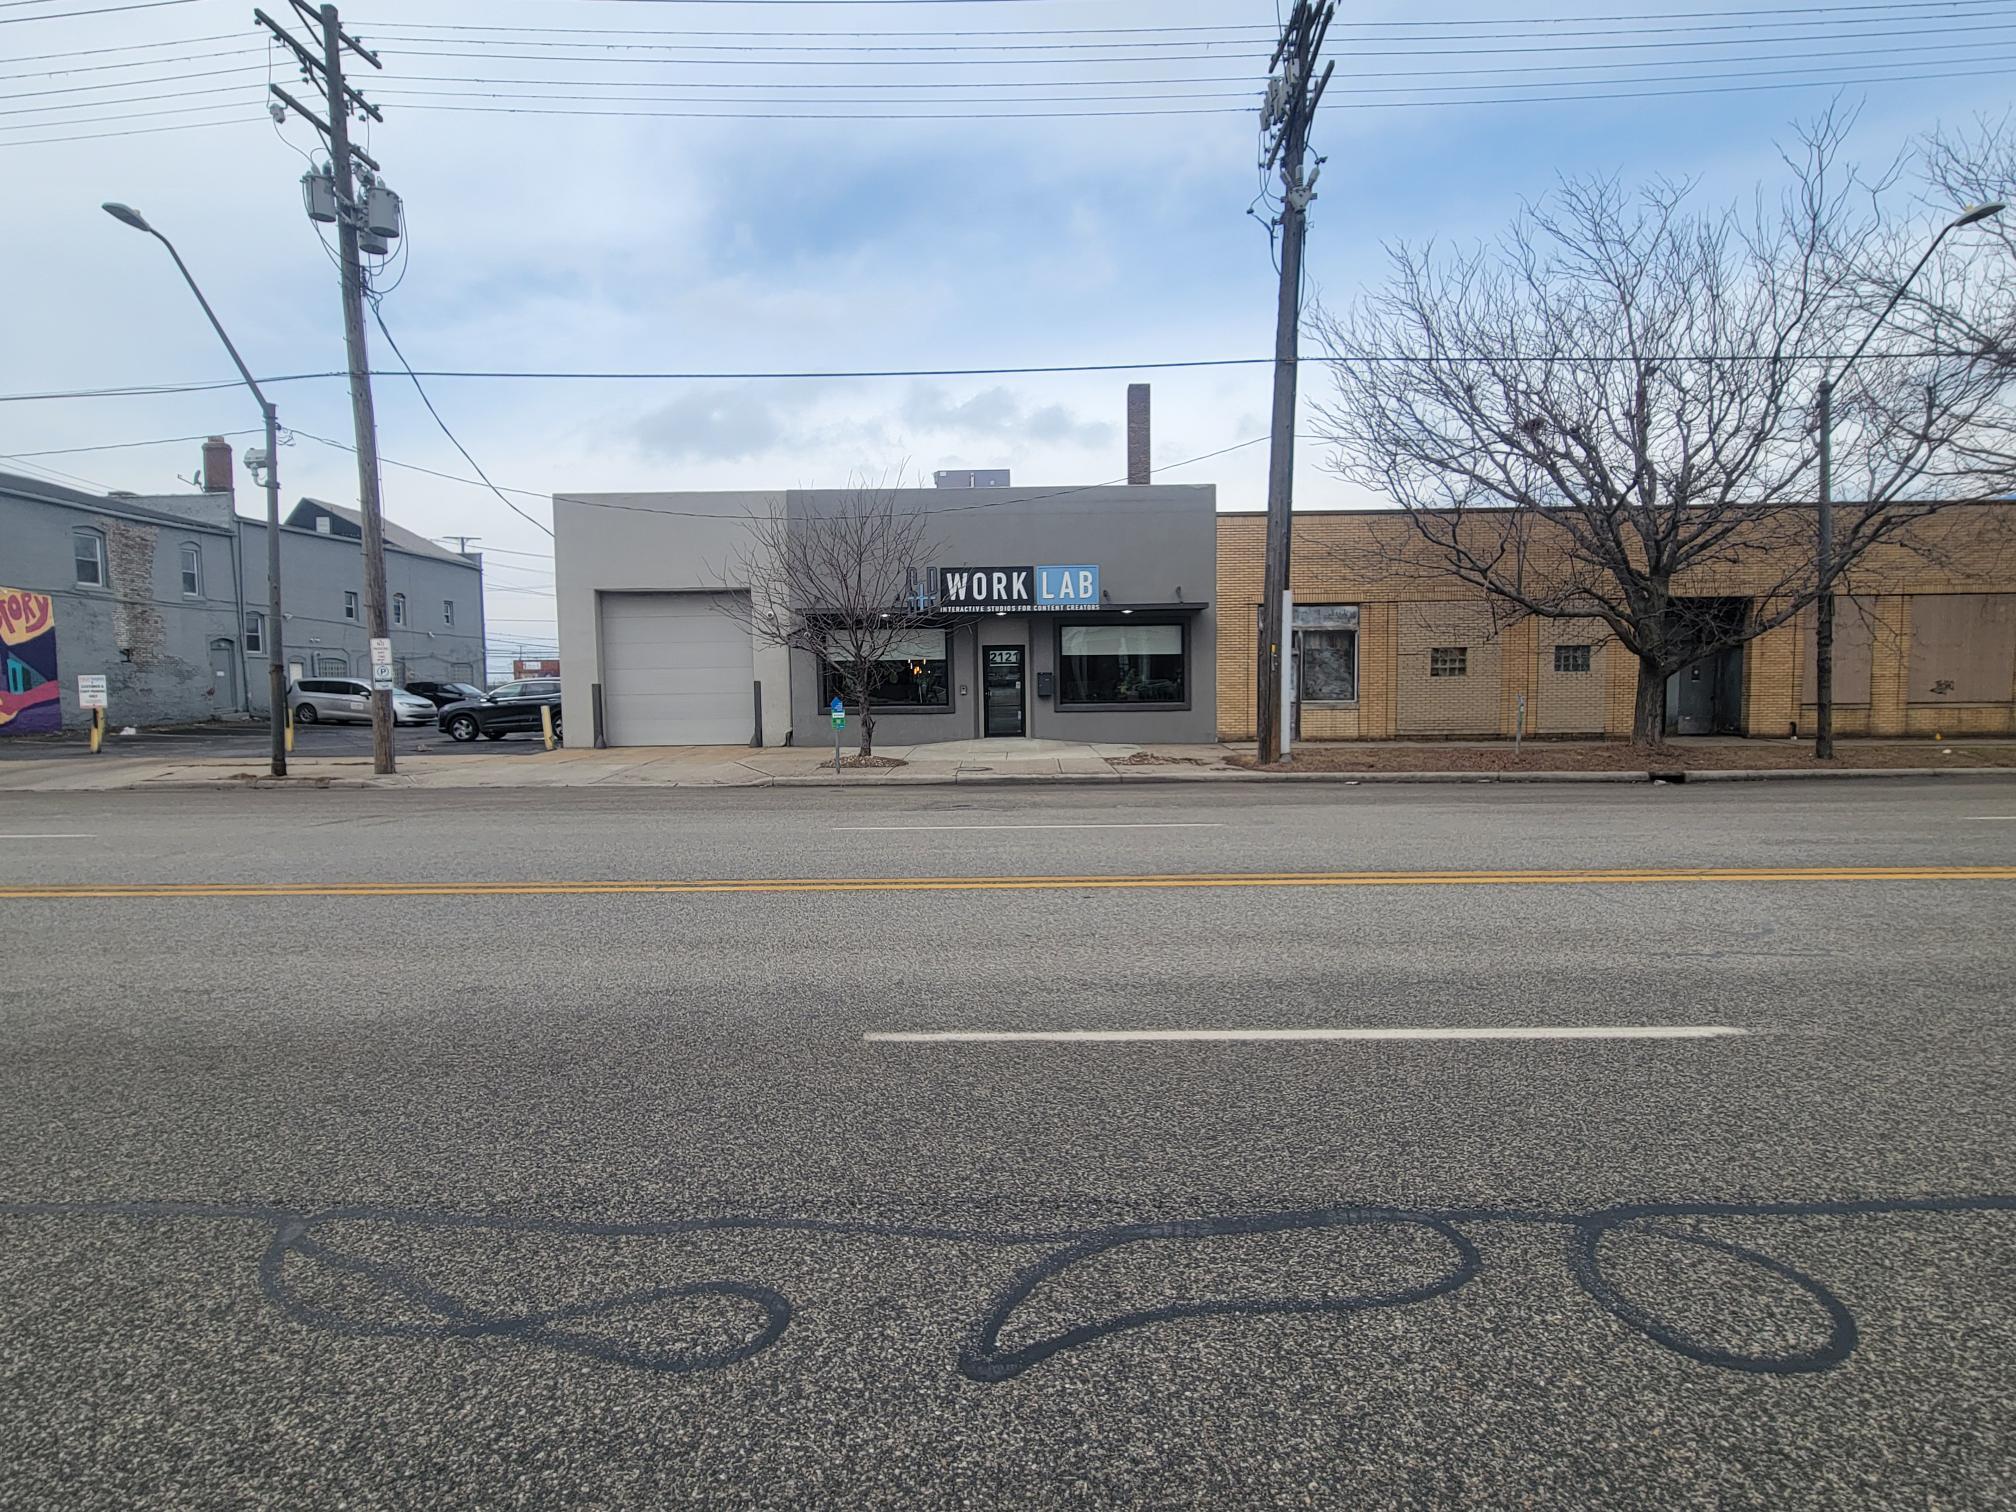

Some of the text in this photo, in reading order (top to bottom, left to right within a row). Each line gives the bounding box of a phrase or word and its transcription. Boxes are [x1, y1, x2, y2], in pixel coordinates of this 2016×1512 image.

[946, 571, 1094, 601] WORK LAB
[940, 605, 985, 613] INTERACTIVE
[1033, 604, 1064, 612] CONTENT
[990, 652, 1018, 663] 2121
